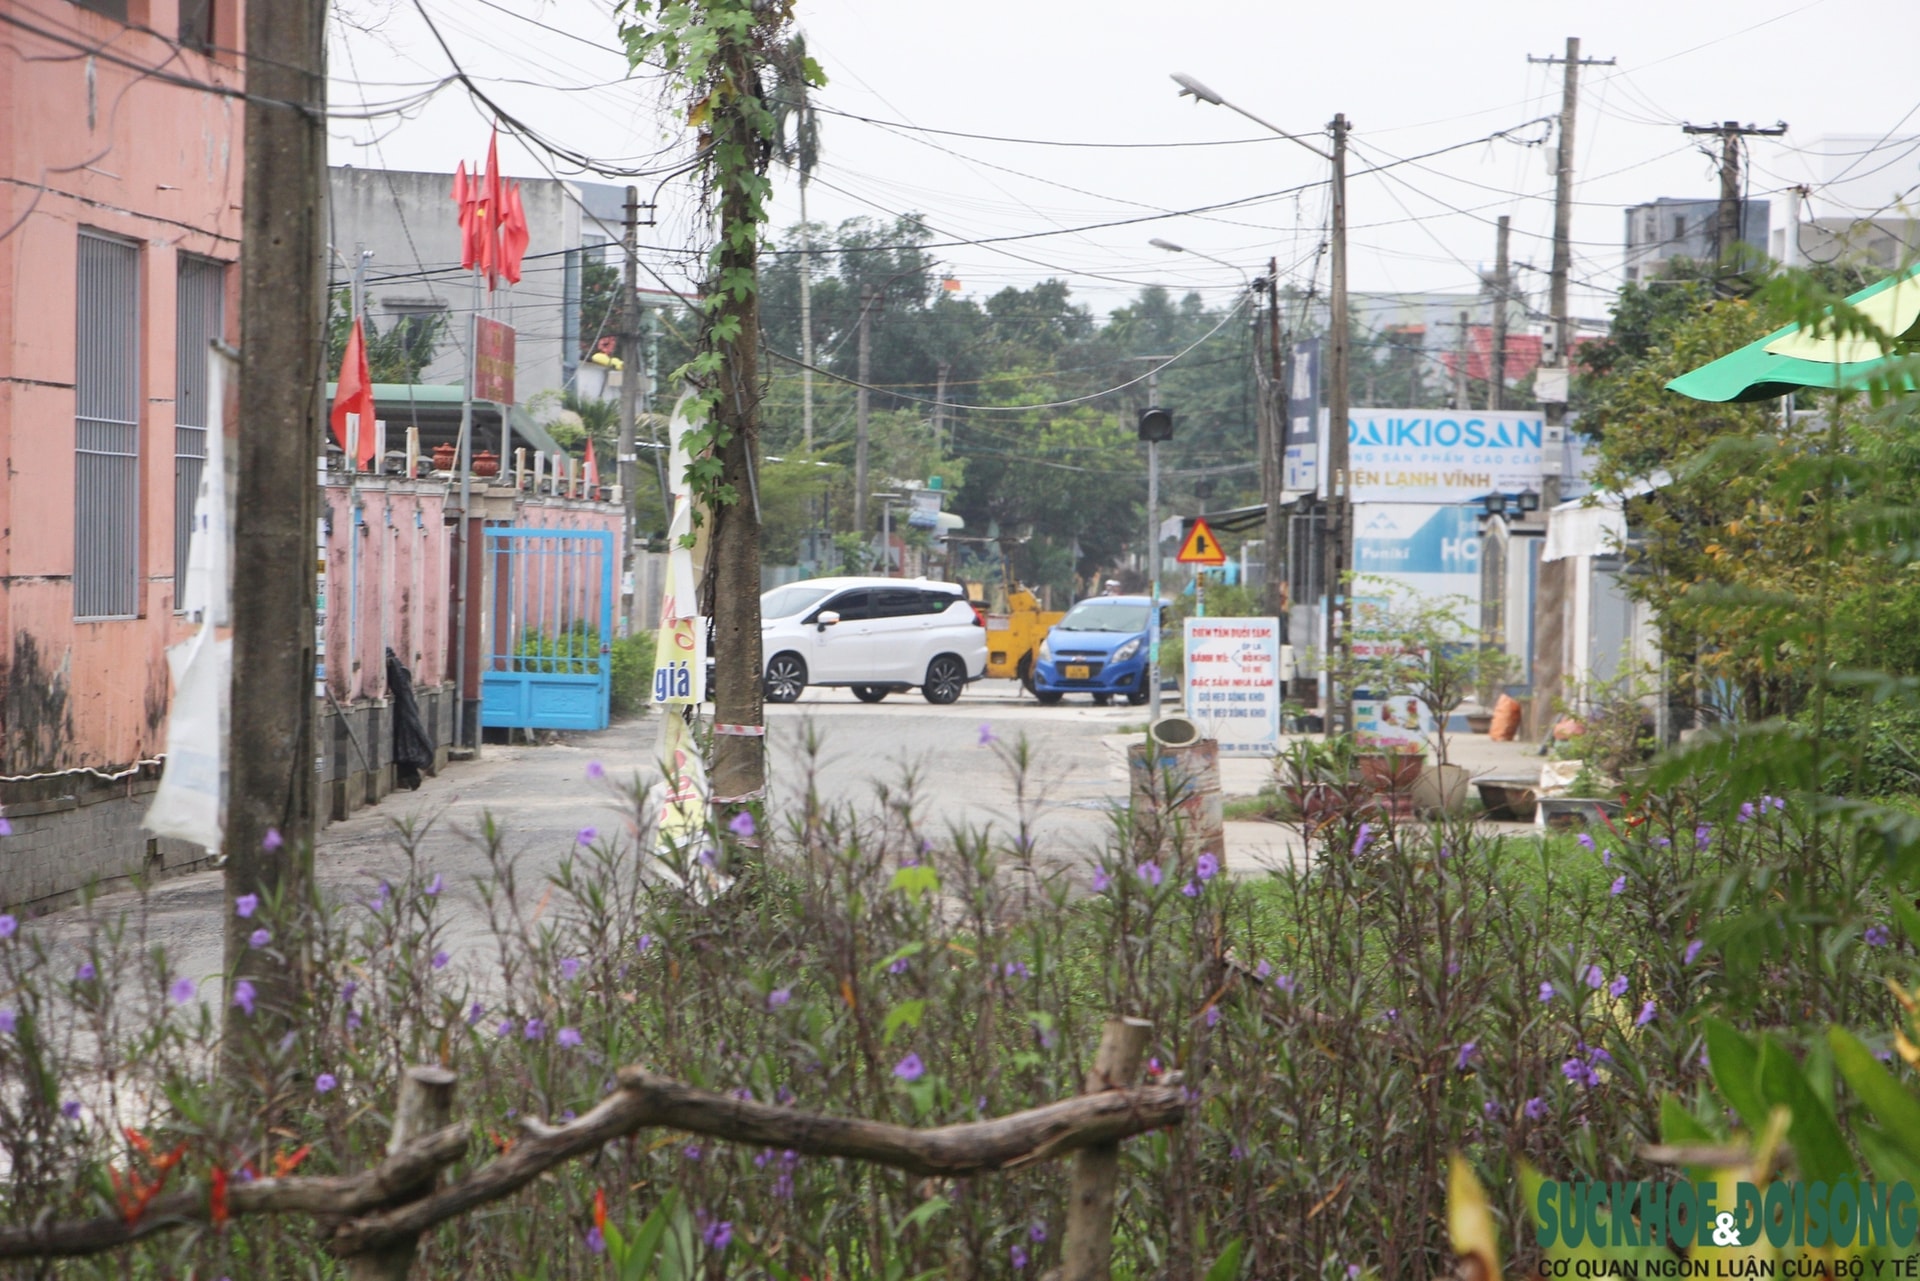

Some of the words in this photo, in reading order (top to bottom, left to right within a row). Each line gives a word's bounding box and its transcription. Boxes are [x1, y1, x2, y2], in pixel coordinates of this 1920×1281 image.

[1385, 471, 1438, 489] LẠNH
[1443, 469, 1491, 487] VĨNH
[656, 661, 690, 702] giá
